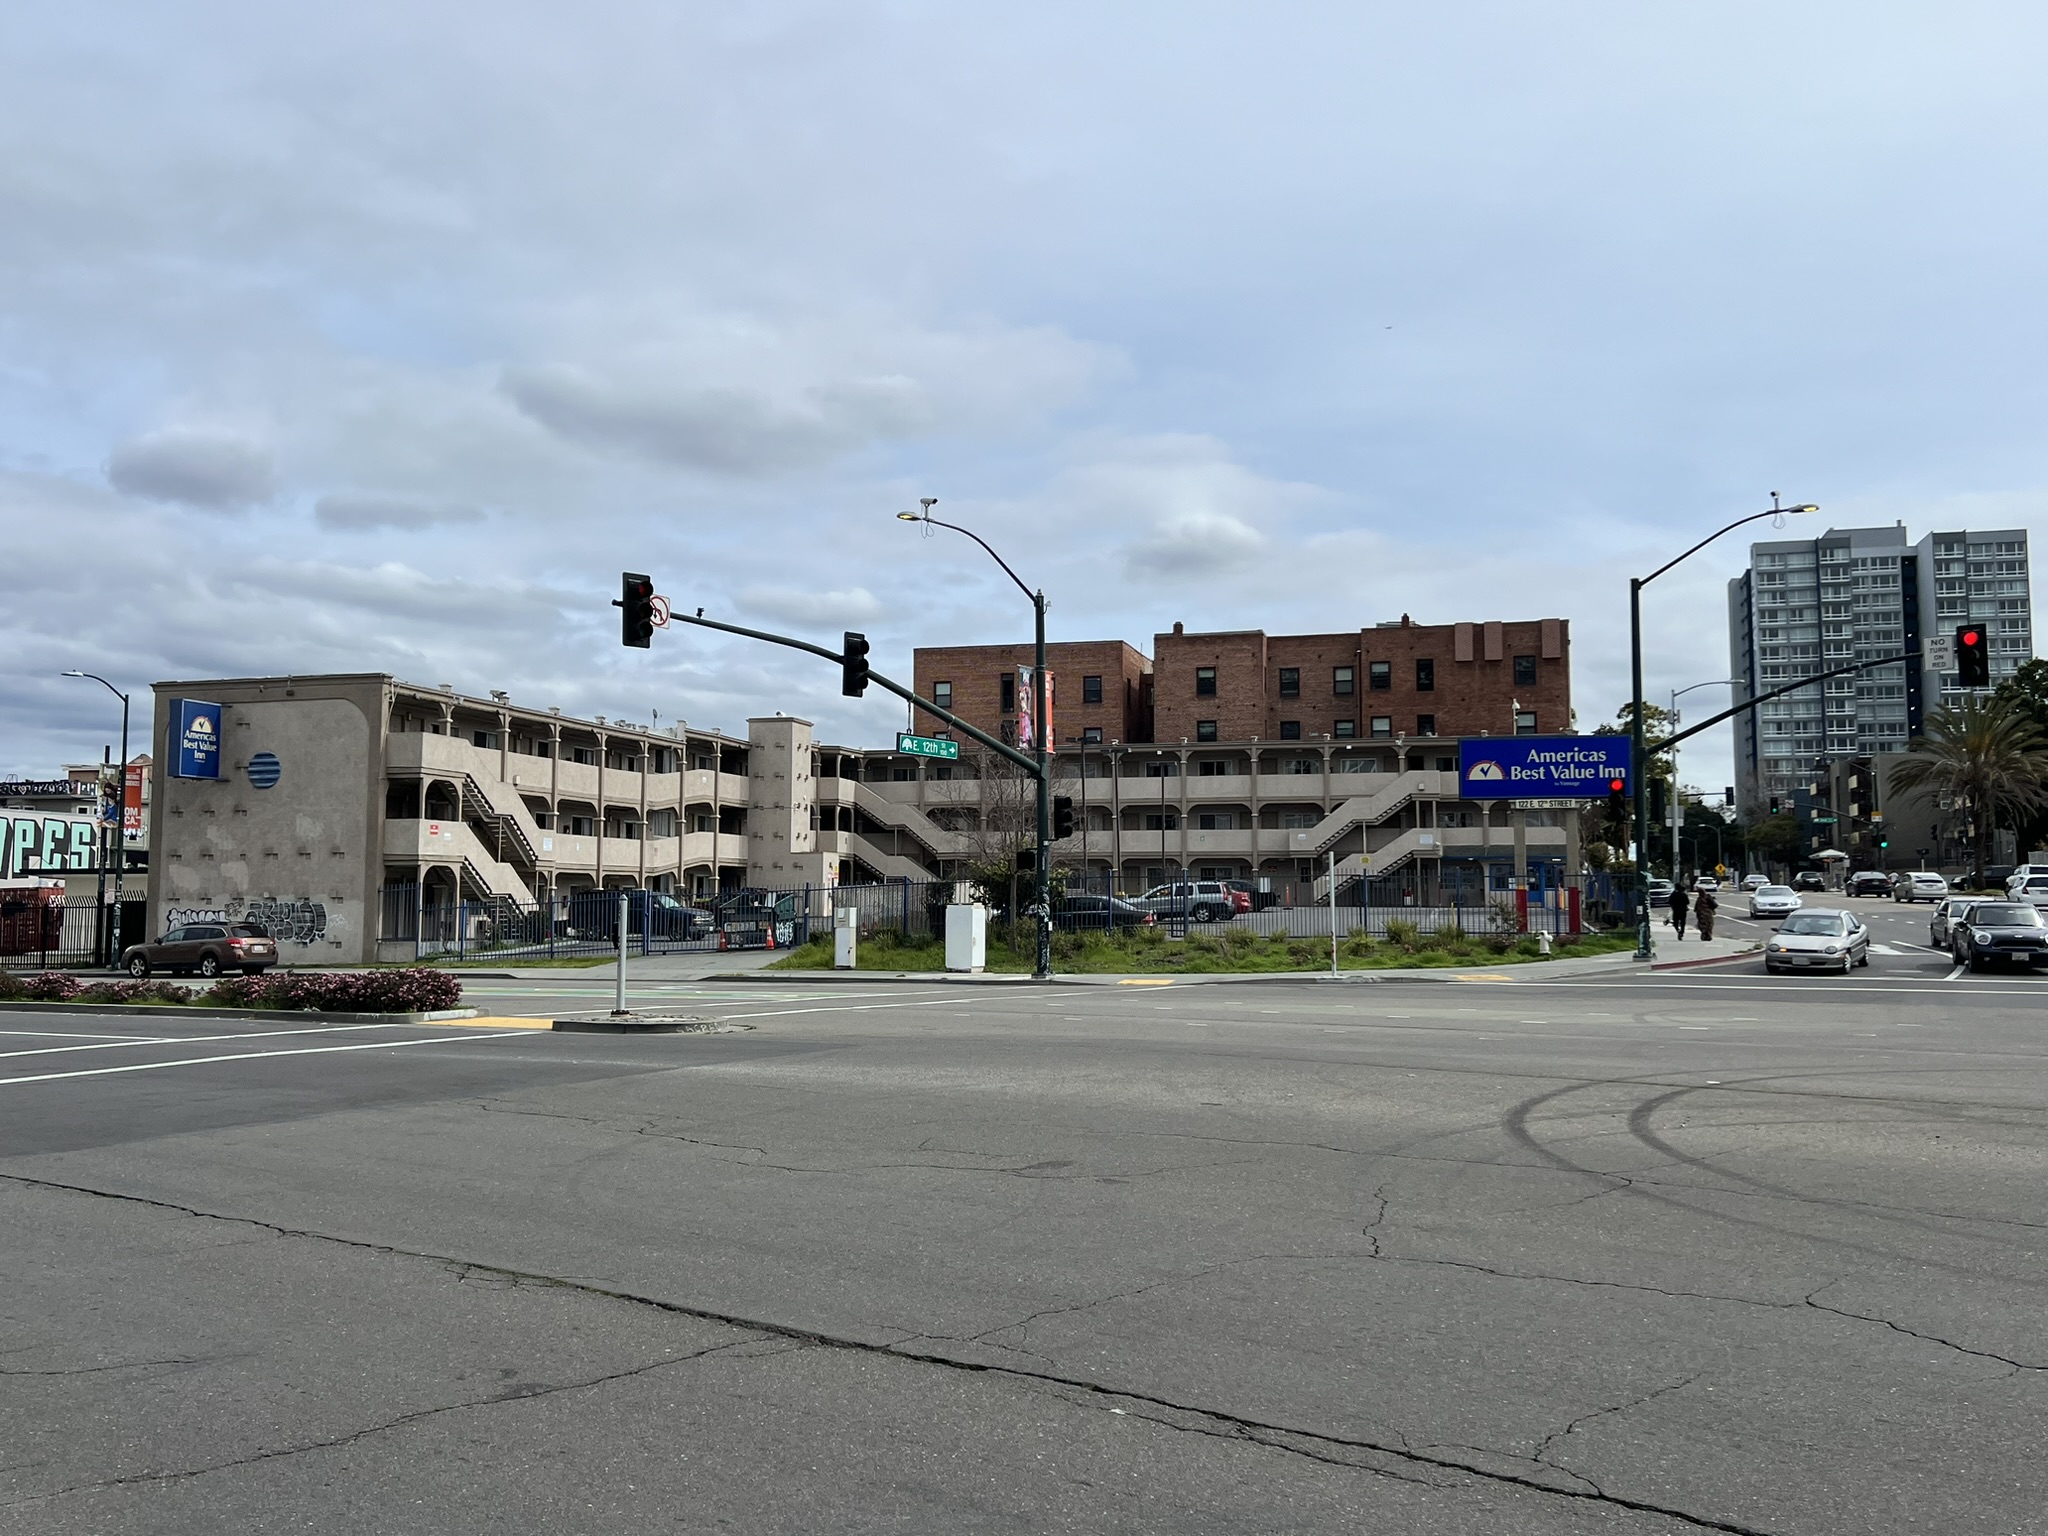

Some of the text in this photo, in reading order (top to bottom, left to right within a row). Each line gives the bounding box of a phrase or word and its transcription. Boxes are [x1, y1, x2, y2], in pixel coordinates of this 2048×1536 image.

[184, 729, 217, 742] Americas
[183, 739, 217, 752] Best Value
[923, 742, 938, 753] 12th
[194, 749, 206, 760] Inn
[1526, 747, 1607, 763] Americas
[1510, 764, 1626, 780] Best Value Inn
[1518, 800, 1528, 808] 122
